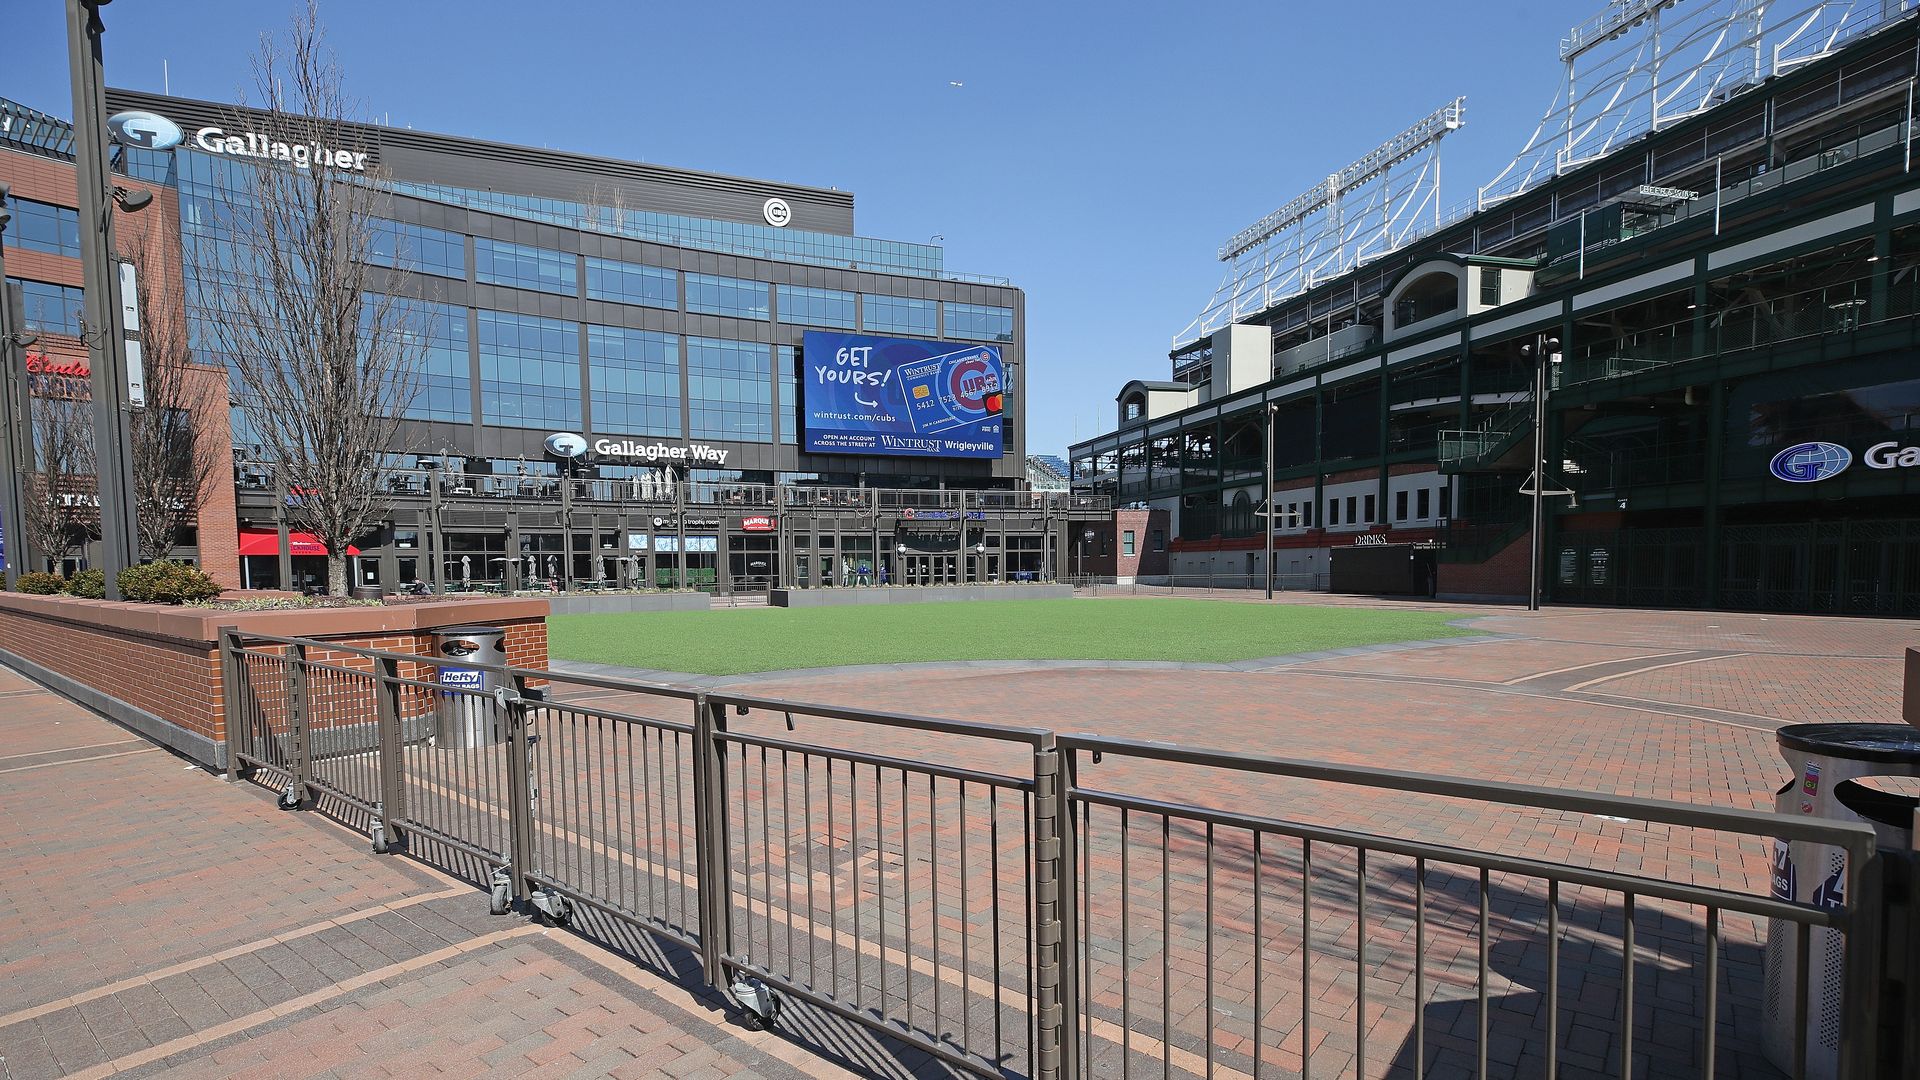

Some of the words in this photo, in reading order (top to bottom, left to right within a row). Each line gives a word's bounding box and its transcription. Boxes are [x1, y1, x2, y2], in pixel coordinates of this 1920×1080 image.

[195, 126, 368, 170] Gallagher
[836, 346, 873, 368] GET
[814, 365, 892, 387] YOURS!
[903, 362, 941, 376] WINTRUST
[916, 399, 936, 410] 5412
[813, 411, 896, 422] wintrust.com/cubs
[881, 435, 942, 449] WINTRUST
[944, 440, 994, 452] Wrigleyville
[594, 439, 689, 461] Gallagher
[690, 444, 728, 464] Way
[1355, 533, 1388, 546] DRINKS
[444, 672, 480, 682] Hefty
